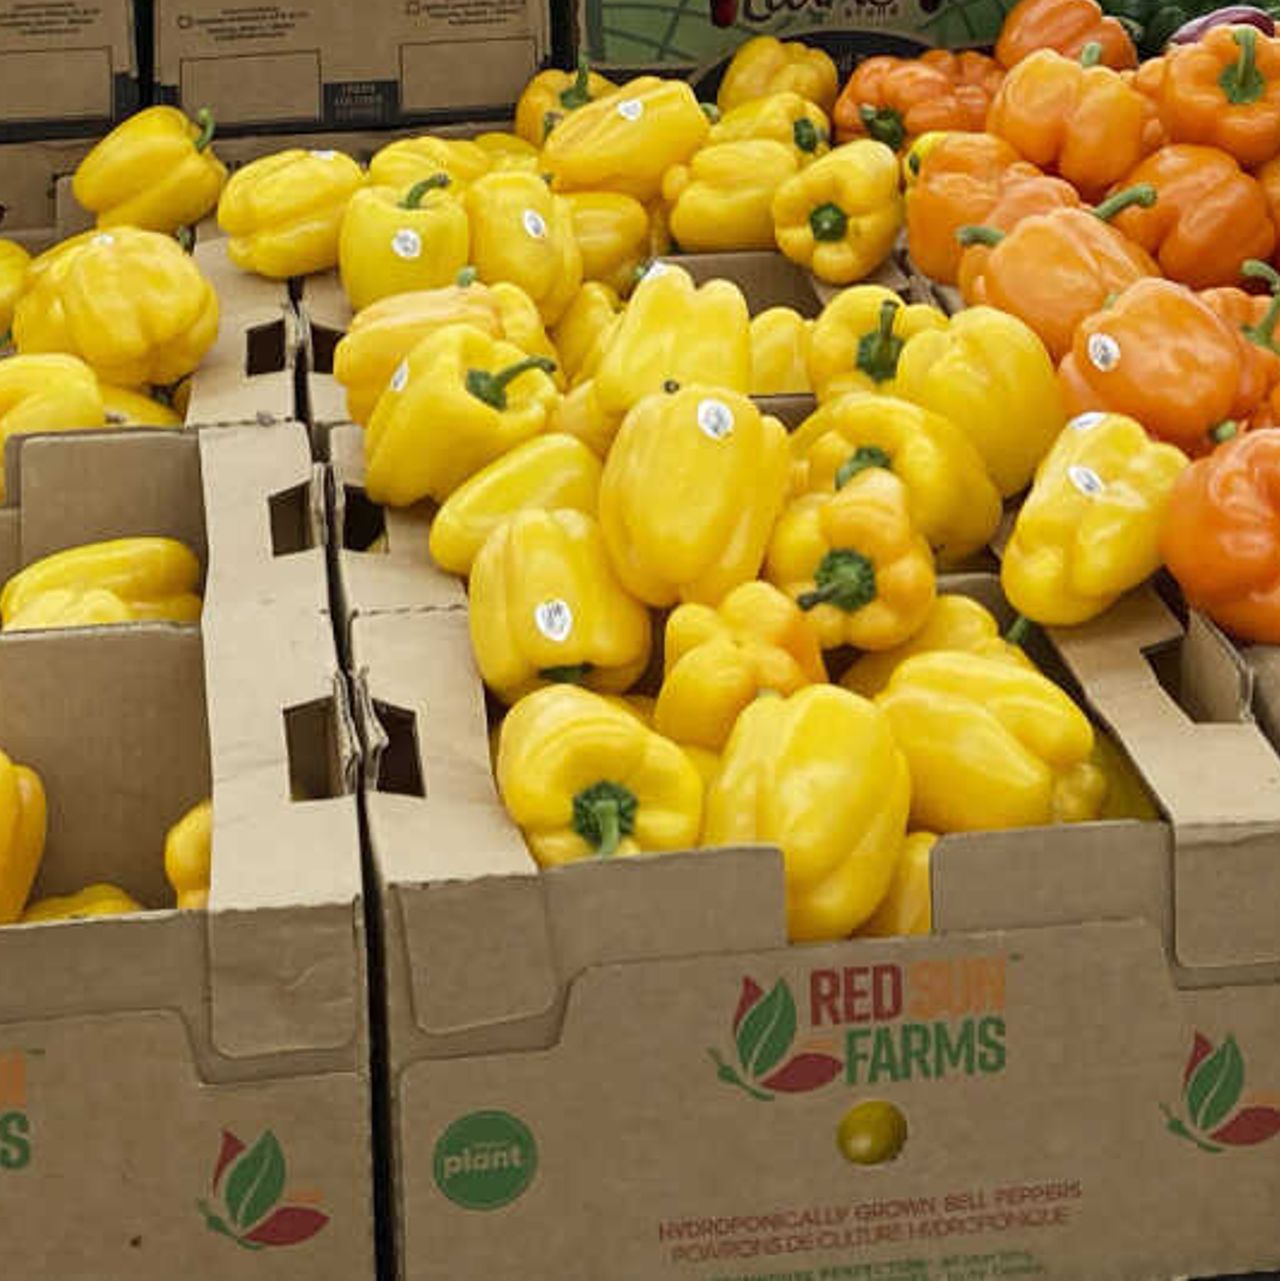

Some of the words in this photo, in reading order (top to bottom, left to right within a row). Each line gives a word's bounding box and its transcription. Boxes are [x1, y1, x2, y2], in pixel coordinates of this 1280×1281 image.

[809, 963, 904, 1027] RED
[908, 955, 1007, 1017] SUN
[844, 1015, 1007, 1086] FARMS
[442, 1142, 526, 1179] plant
